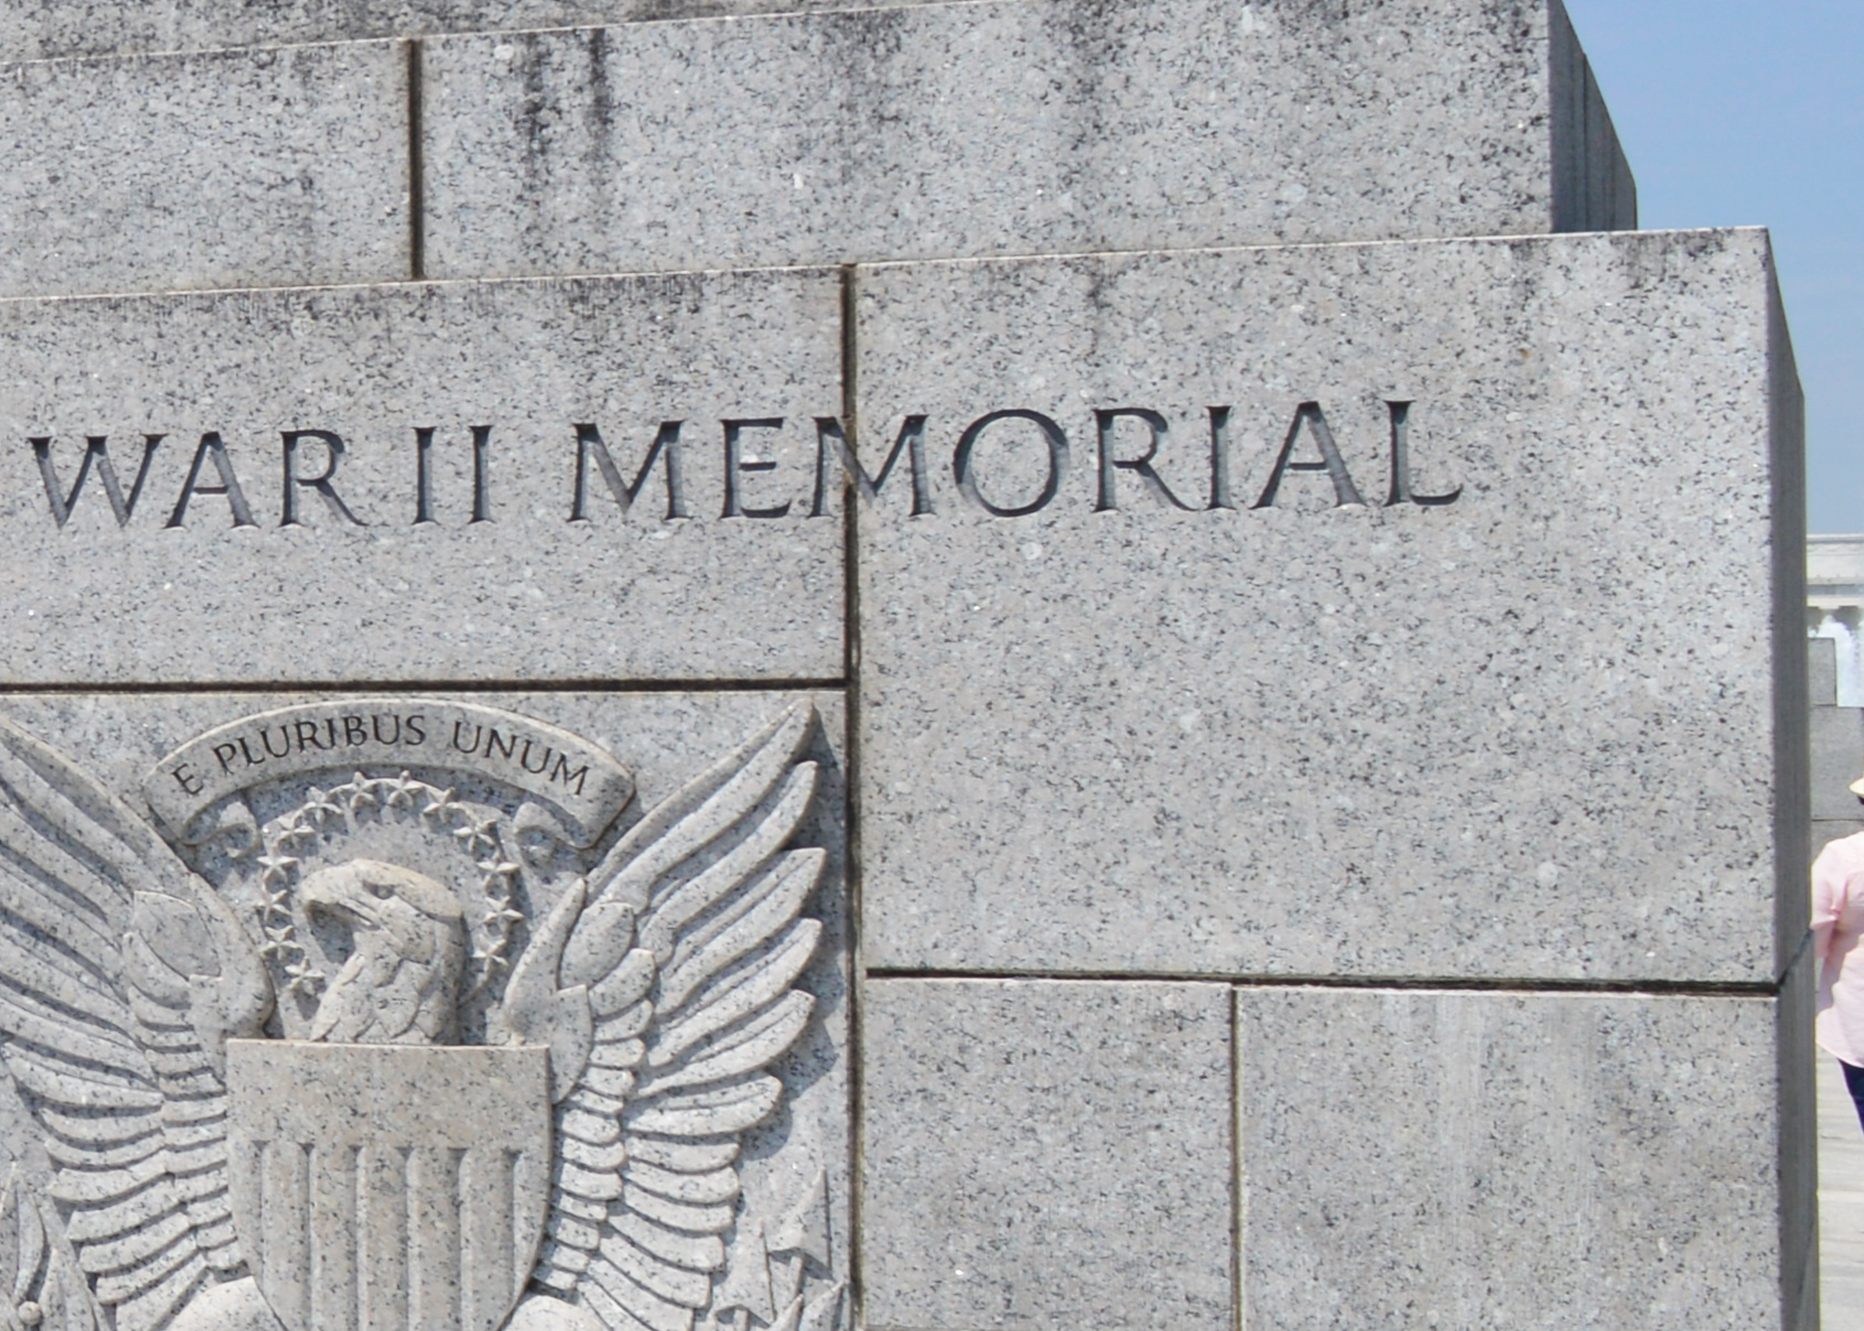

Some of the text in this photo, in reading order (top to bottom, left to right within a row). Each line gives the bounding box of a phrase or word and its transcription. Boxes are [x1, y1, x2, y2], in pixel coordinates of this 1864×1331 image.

[27, 428, 369, 529] WAR
[411, 424, 496, 526] II
[567, 399, 1464, 523] MEMORIAL
[172, 714, 592, 798] E PLURIBUS UNUM
